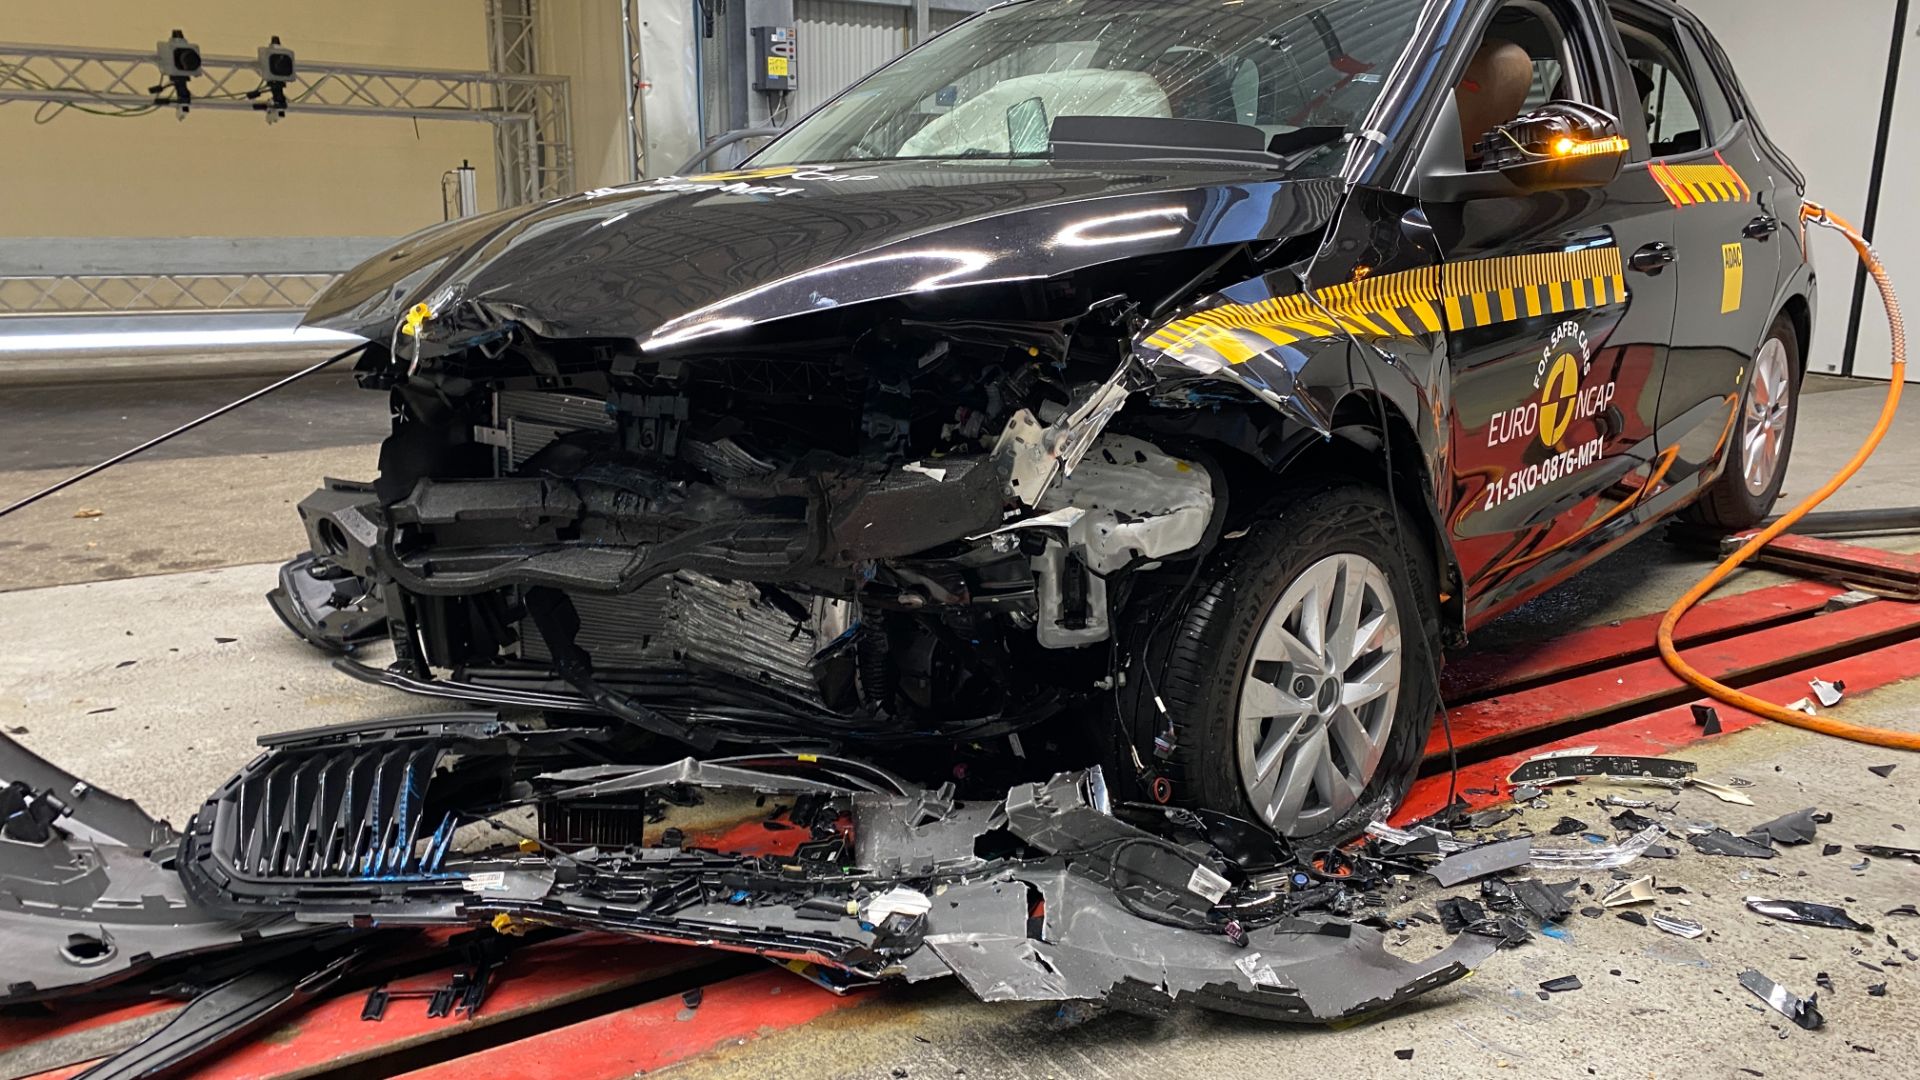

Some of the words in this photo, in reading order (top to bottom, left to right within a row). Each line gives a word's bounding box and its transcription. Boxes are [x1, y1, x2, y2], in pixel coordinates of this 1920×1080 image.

[1724, 246, 1742, 268] ADAC
[1533, 346, 1552, 390] FOR
[1551, 320, 1579, 349] SAFER
[1578, 330, 1592, 376] CARS
[1487, 402, 1538, 448] EURO
[1574, 381, 1616, 421] NCAP
[1484, 434, 1605, 512] 21-SKO-0876-MP1
